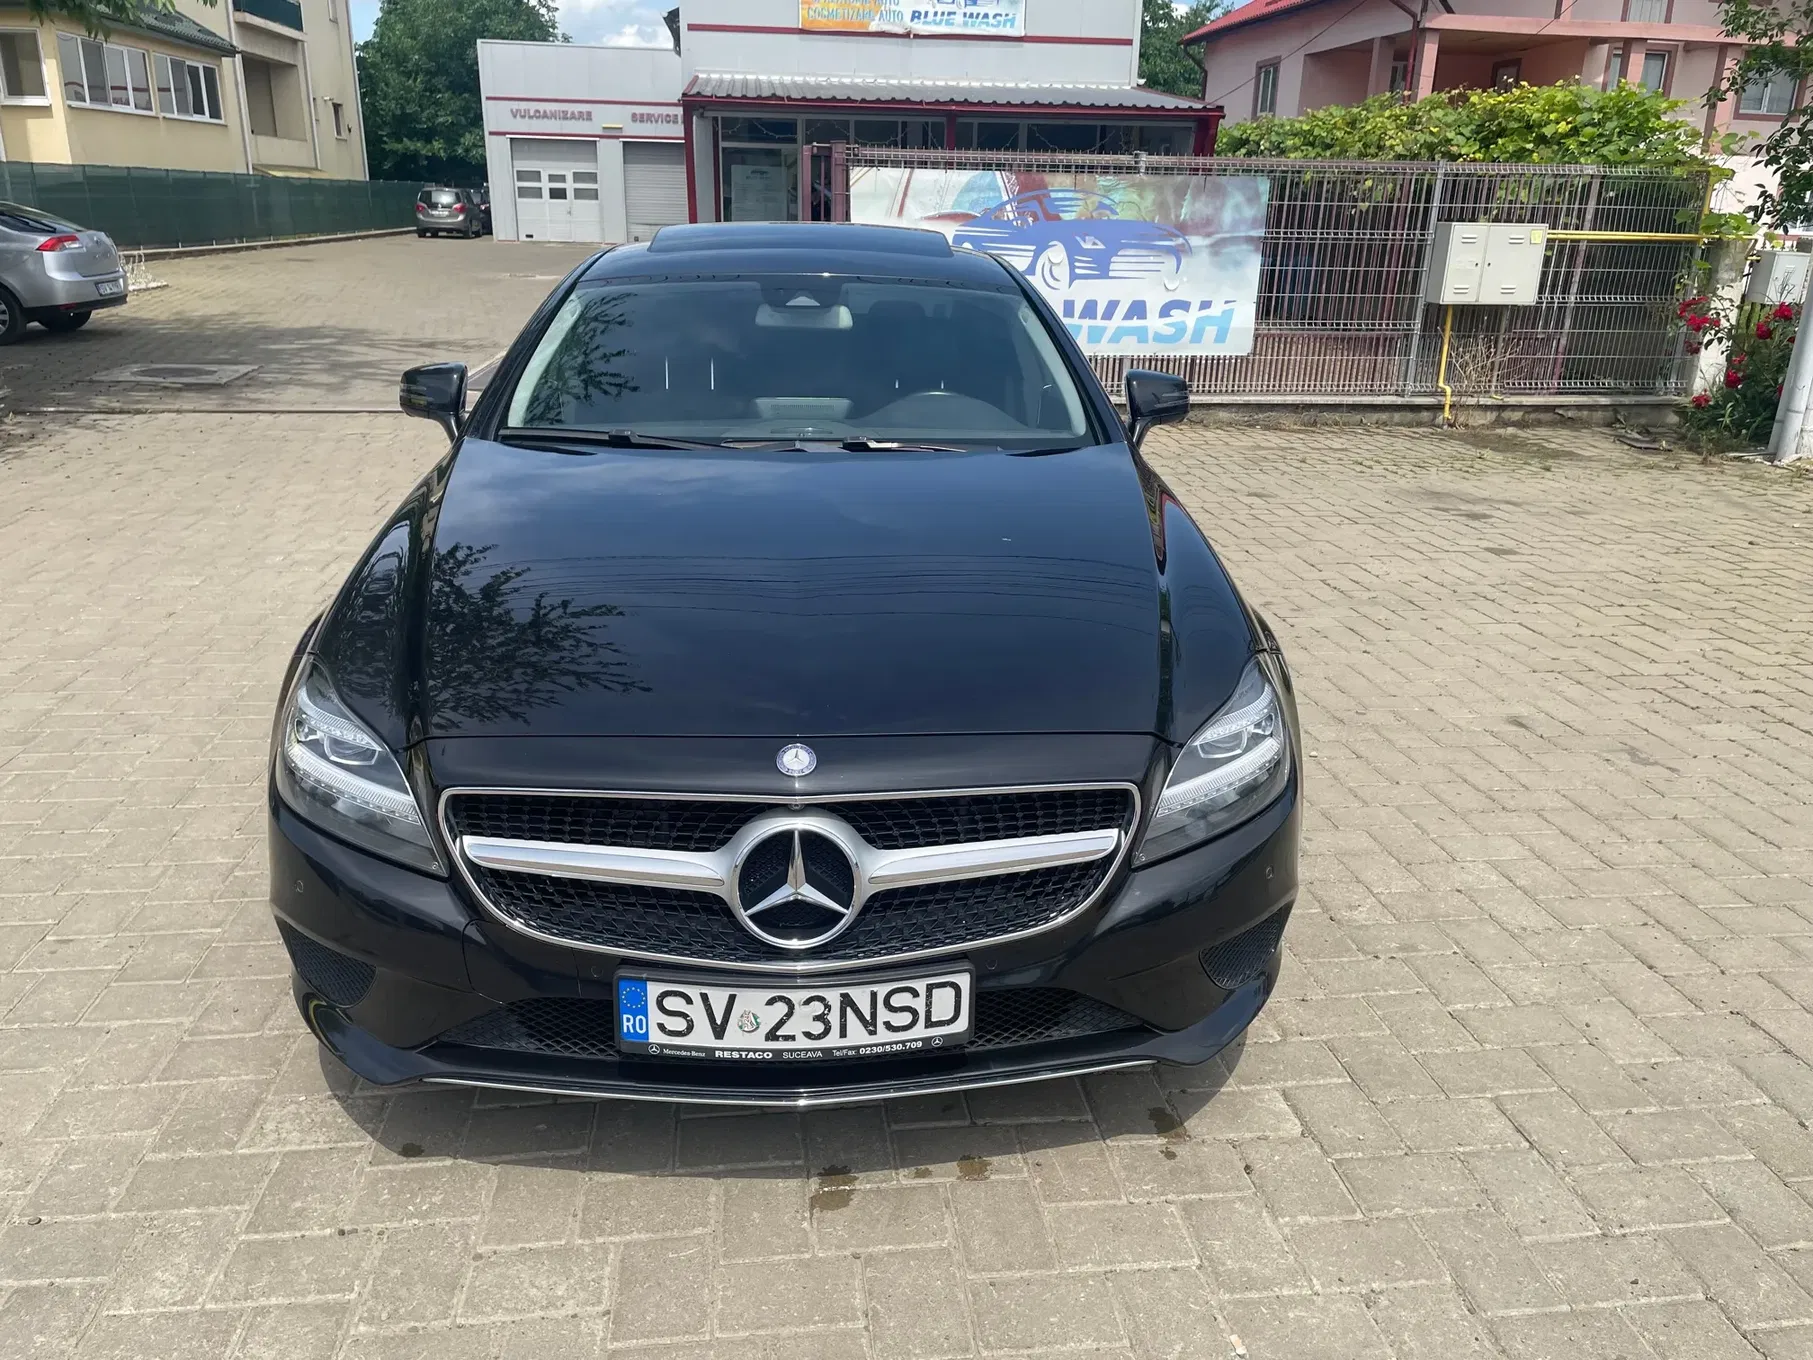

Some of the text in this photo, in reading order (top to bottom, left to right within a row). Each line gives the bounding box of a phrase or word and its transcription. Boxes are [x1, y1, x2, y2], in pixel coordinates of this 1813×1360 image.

[879, 9, 904, 23] AUTO
[910, 10, 1017, 29] BLUE WASH
[510, 108, 593, 121] VULCANIZARE
[631, 112, 679, 125] SERVICE
[1063, 299, 1236, 344] WASH
[656, 989, 737, 1040] SV
[622, 1015, 647, 1034] RO
[662, 1048, 706, 1058] Mercedes-Benz
[715, 1050, 773, 1059] RESTACO
[782, 1051, 823, 1059] SUCEAVA
[859, 1040, 923, 1055] 0230/530.709
